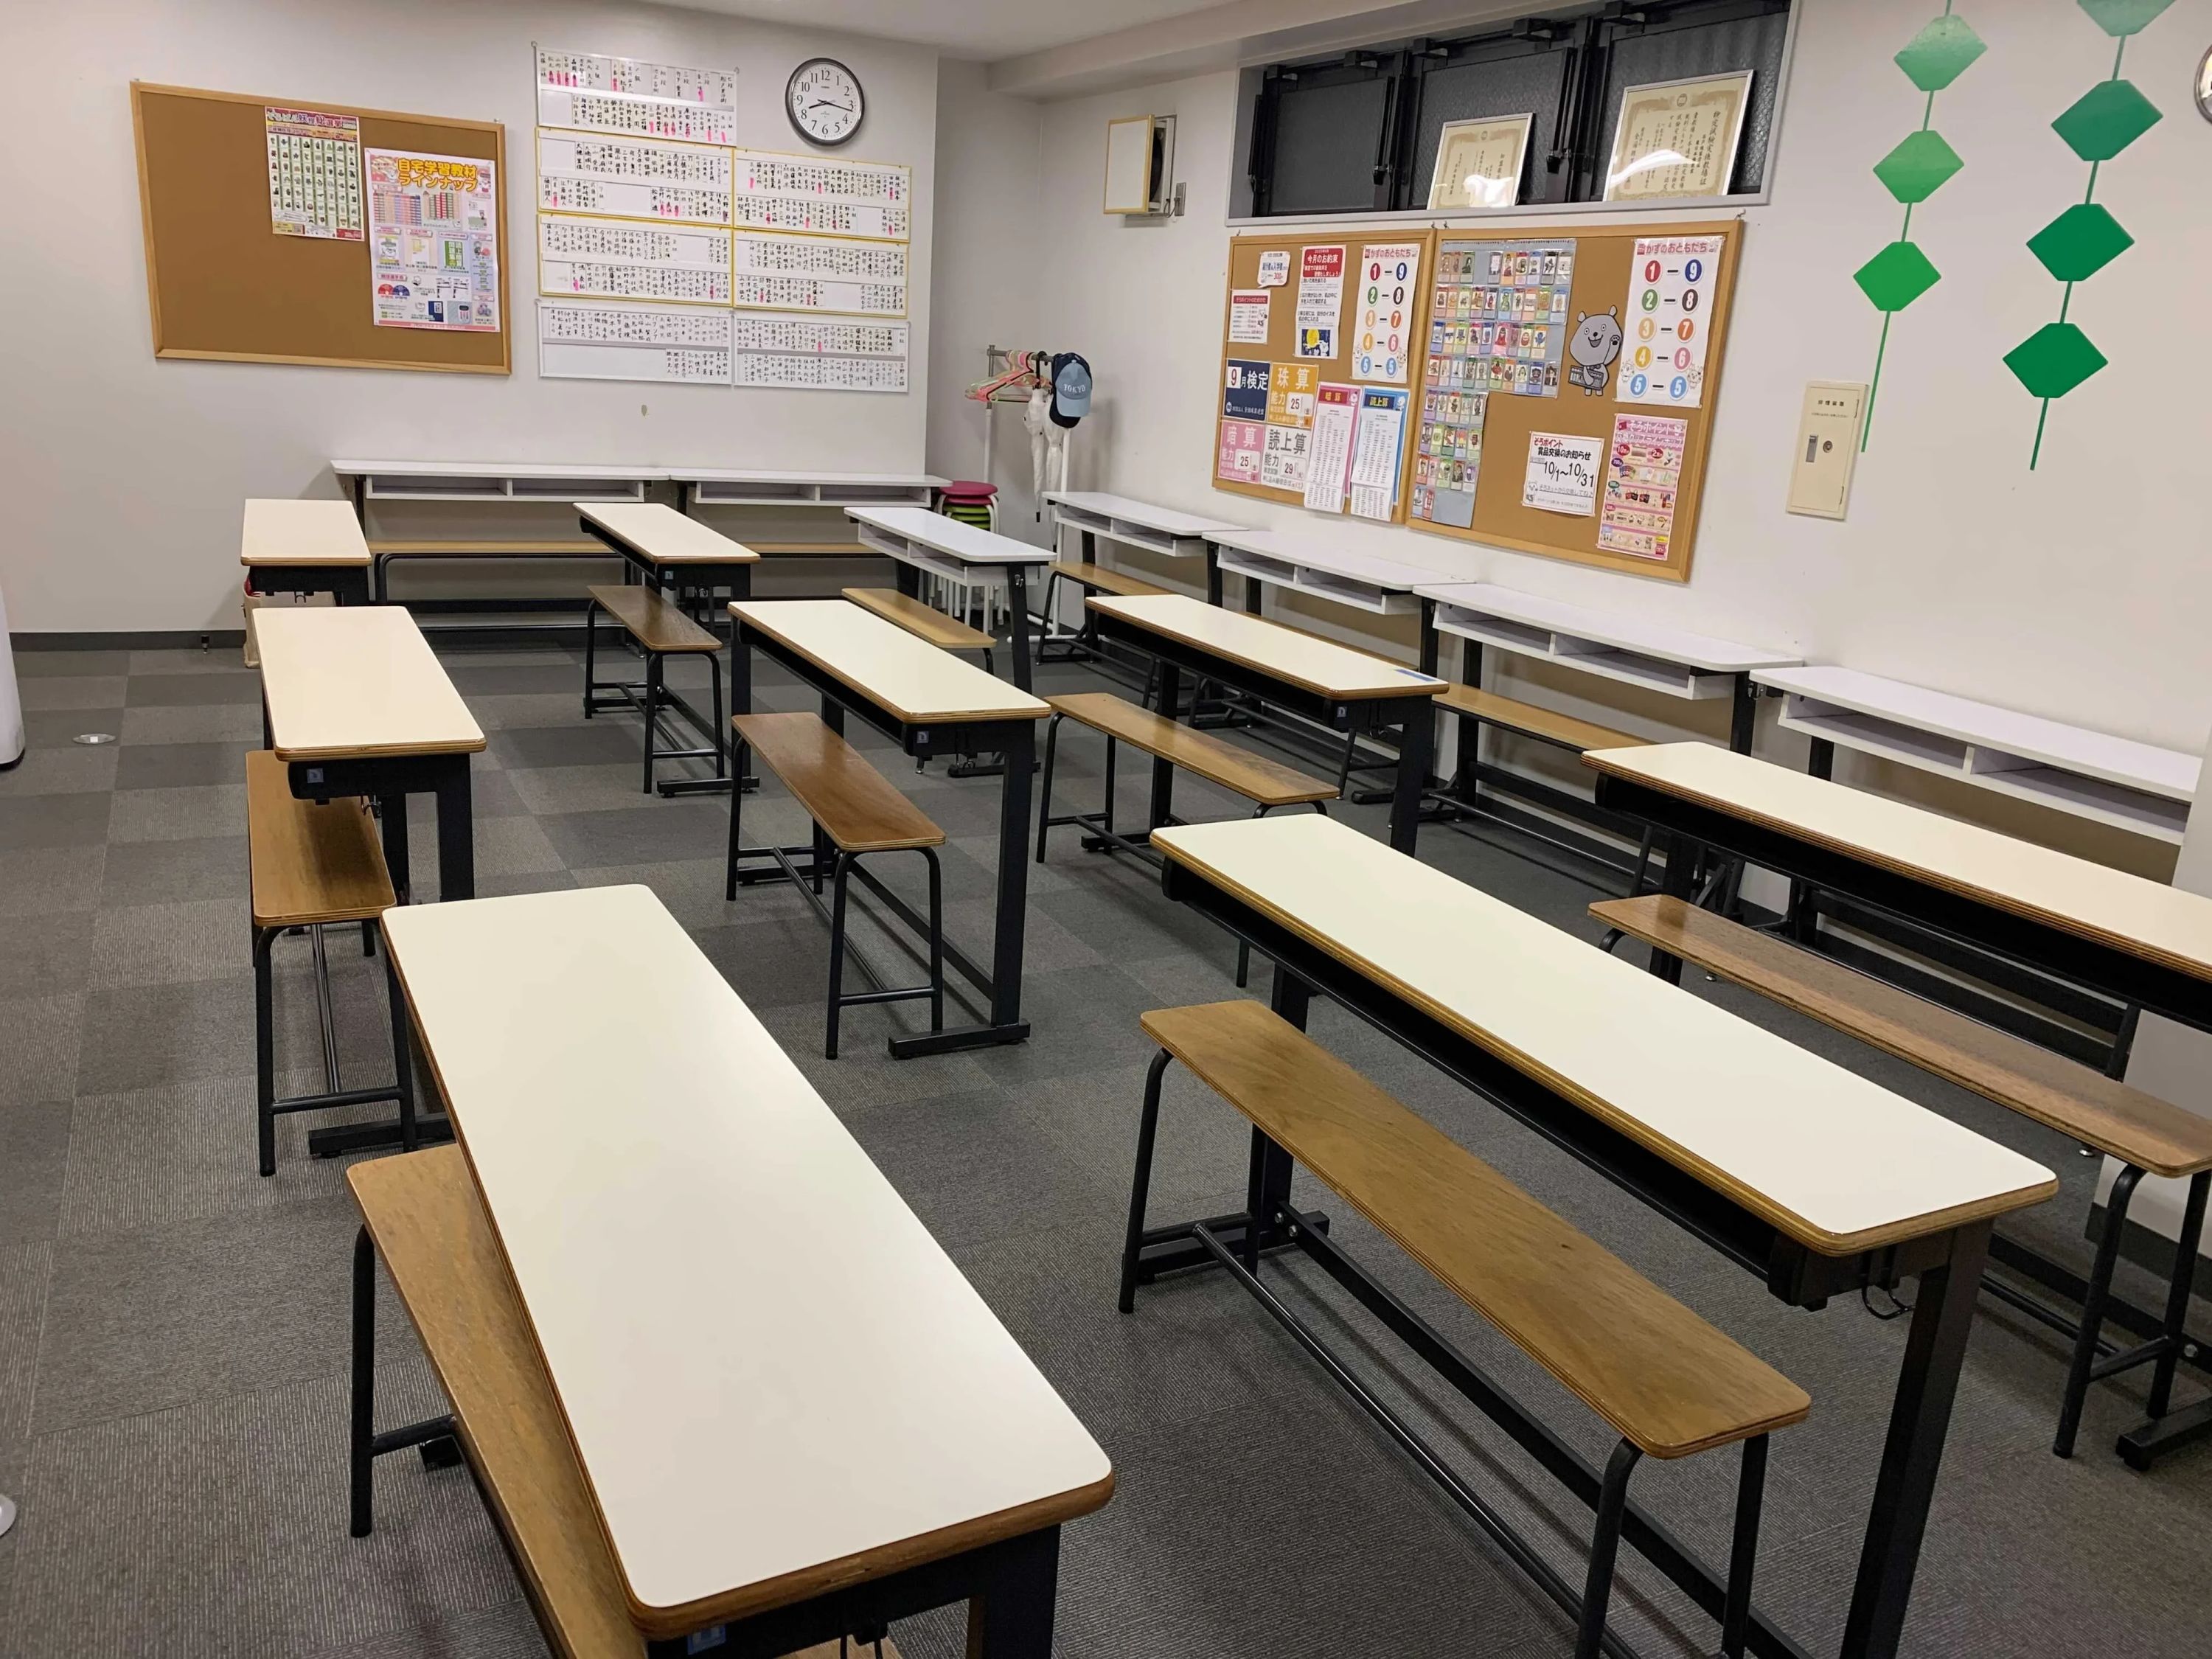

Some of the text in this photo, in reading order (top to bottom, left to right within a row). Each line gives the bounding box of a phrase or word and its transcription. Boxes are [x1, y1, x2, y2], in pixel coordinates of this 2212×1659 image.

[811, 72, 818, 83] 11
[821, 69, 830, 80] 12
[836, 75, 839, 86] 1
[801, 81, 810, 92] 10
[844, 86, 849, 96] 2
[796, 94, 803, 105] 9
[849, 100, 854, 111] 3
[801, 109, 807, 119] 8
[842, 113, 849, 124] 4
[811, 119, 817, 131] 7
[821, 123, 829, 135] 6
[835, 122, 840, 133] 5
[398, 158, 478, 178] 自宅学習教材
[398, 173, 478, 192] ラインナップ
[1371, 248, 1411, 258] かずのおともだち
[1646, 242, 1707, 254] かずのおともだち
[1307, 254, 1338, 263] 今月のお約束
[1231, 368, 1268, 390] 9月検定
[1277, 367, 1310, 390] 珠算
[1063, 383, 1086, 393] TOKYO
[1270, 391, 1285, 406] 能力
[1290, 398, 1300, 410] 25
[1227, 425, 1256, 448] 暗算
[1268, 429, 1307, 455] 読上算
[1534, 437, 1563, 448] そろポイント
[1264, 451, 1279, 467] 能力
[1538, 446, 1591, 461] 賞品交換のお知らせ
[1240, 456, 1248, 467] 25
[1284, 463, 1293, 474] 29
